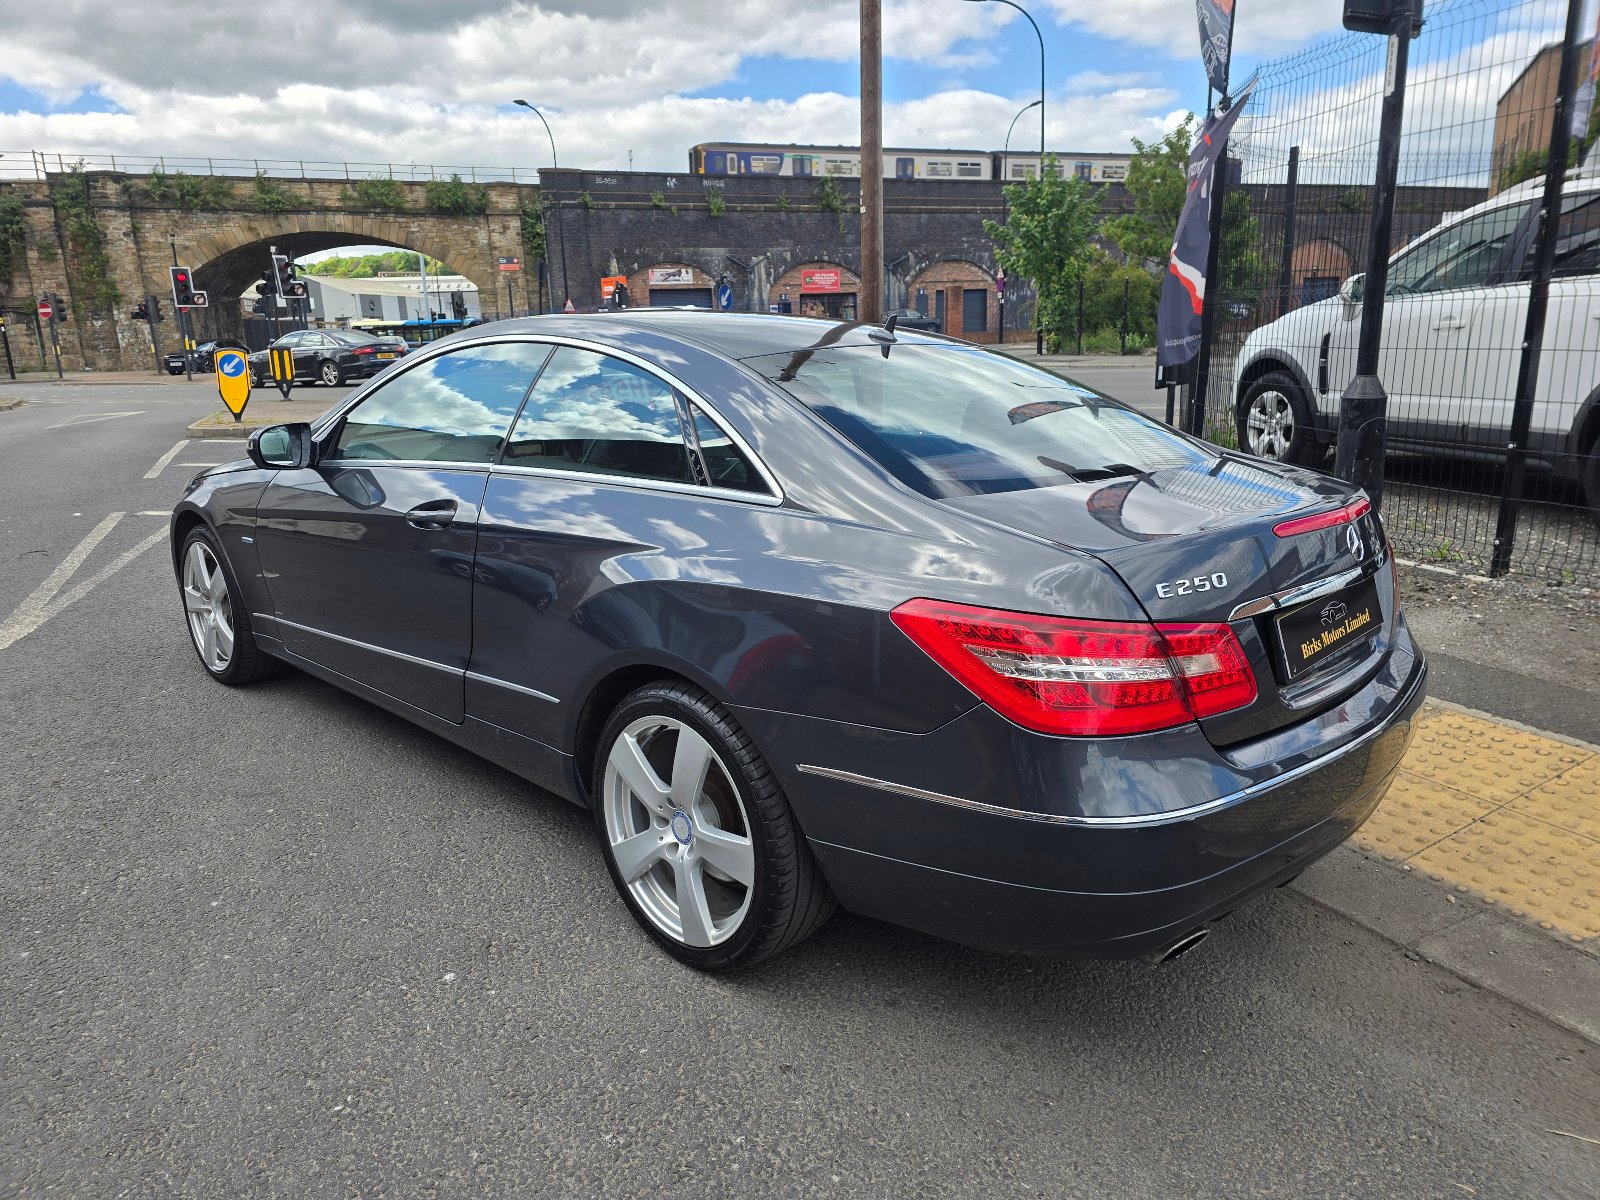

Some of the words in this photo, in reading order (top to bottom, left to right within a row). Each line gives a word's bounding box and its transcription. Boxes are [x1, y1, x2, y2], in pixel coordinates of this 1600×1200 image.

[1155, 572, 1228, 599] E250
[1301, 638, 1323, 659] Birks
[1321, 624, 1346, 647] Motors
[1345, 607, 1371, 634] Limited
